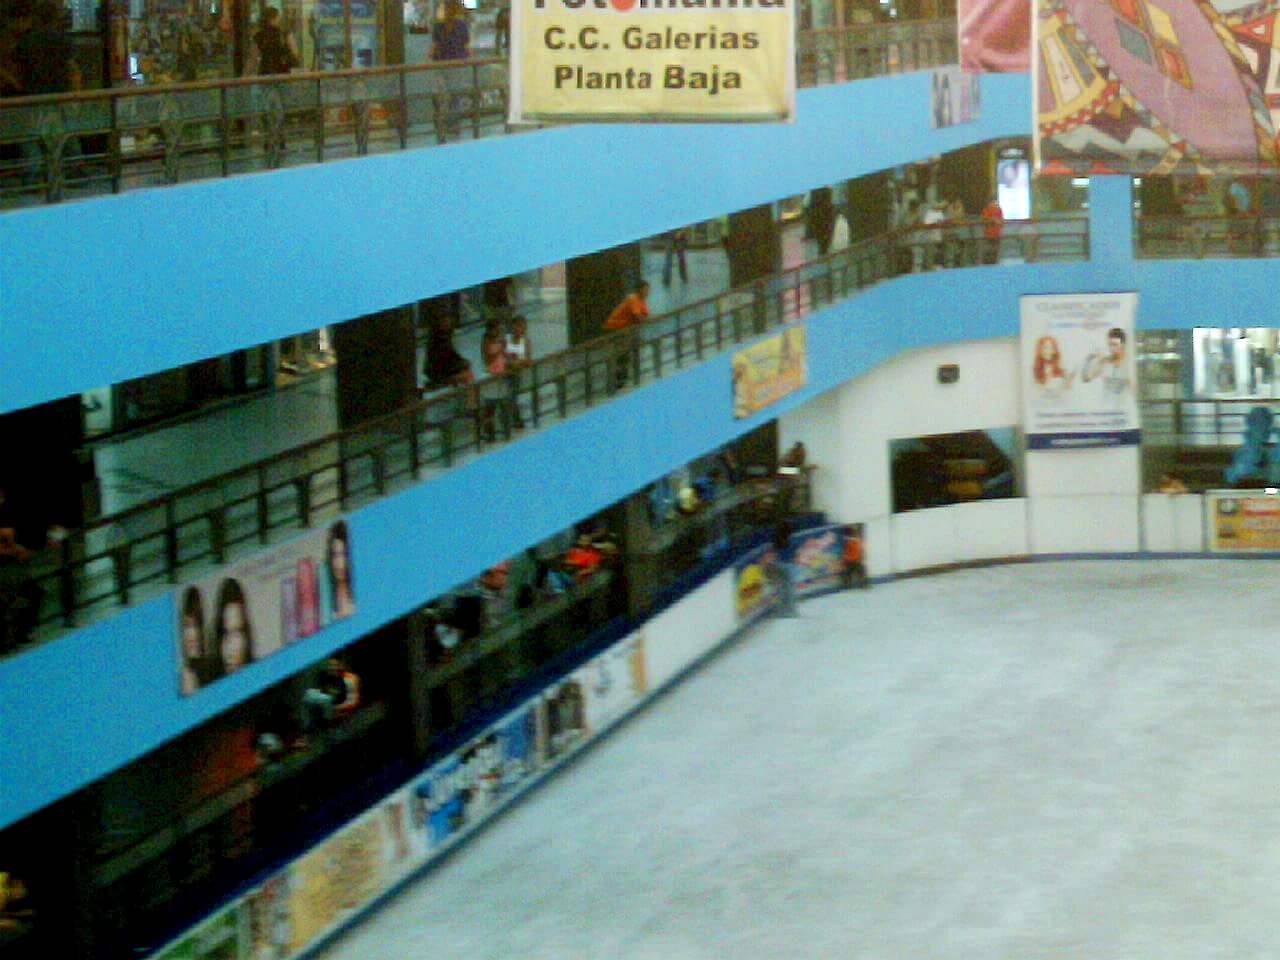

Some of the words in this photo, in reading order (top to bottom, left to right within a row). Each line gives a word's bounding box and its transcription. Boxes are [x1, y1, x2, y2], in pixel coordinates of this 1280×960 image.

[544, 25, 610, 51] C.C.
[622, 25, 761, 50] Galerias
[553, 65, 653, 91] Planta
[663, 63, 743, 97] Baja
